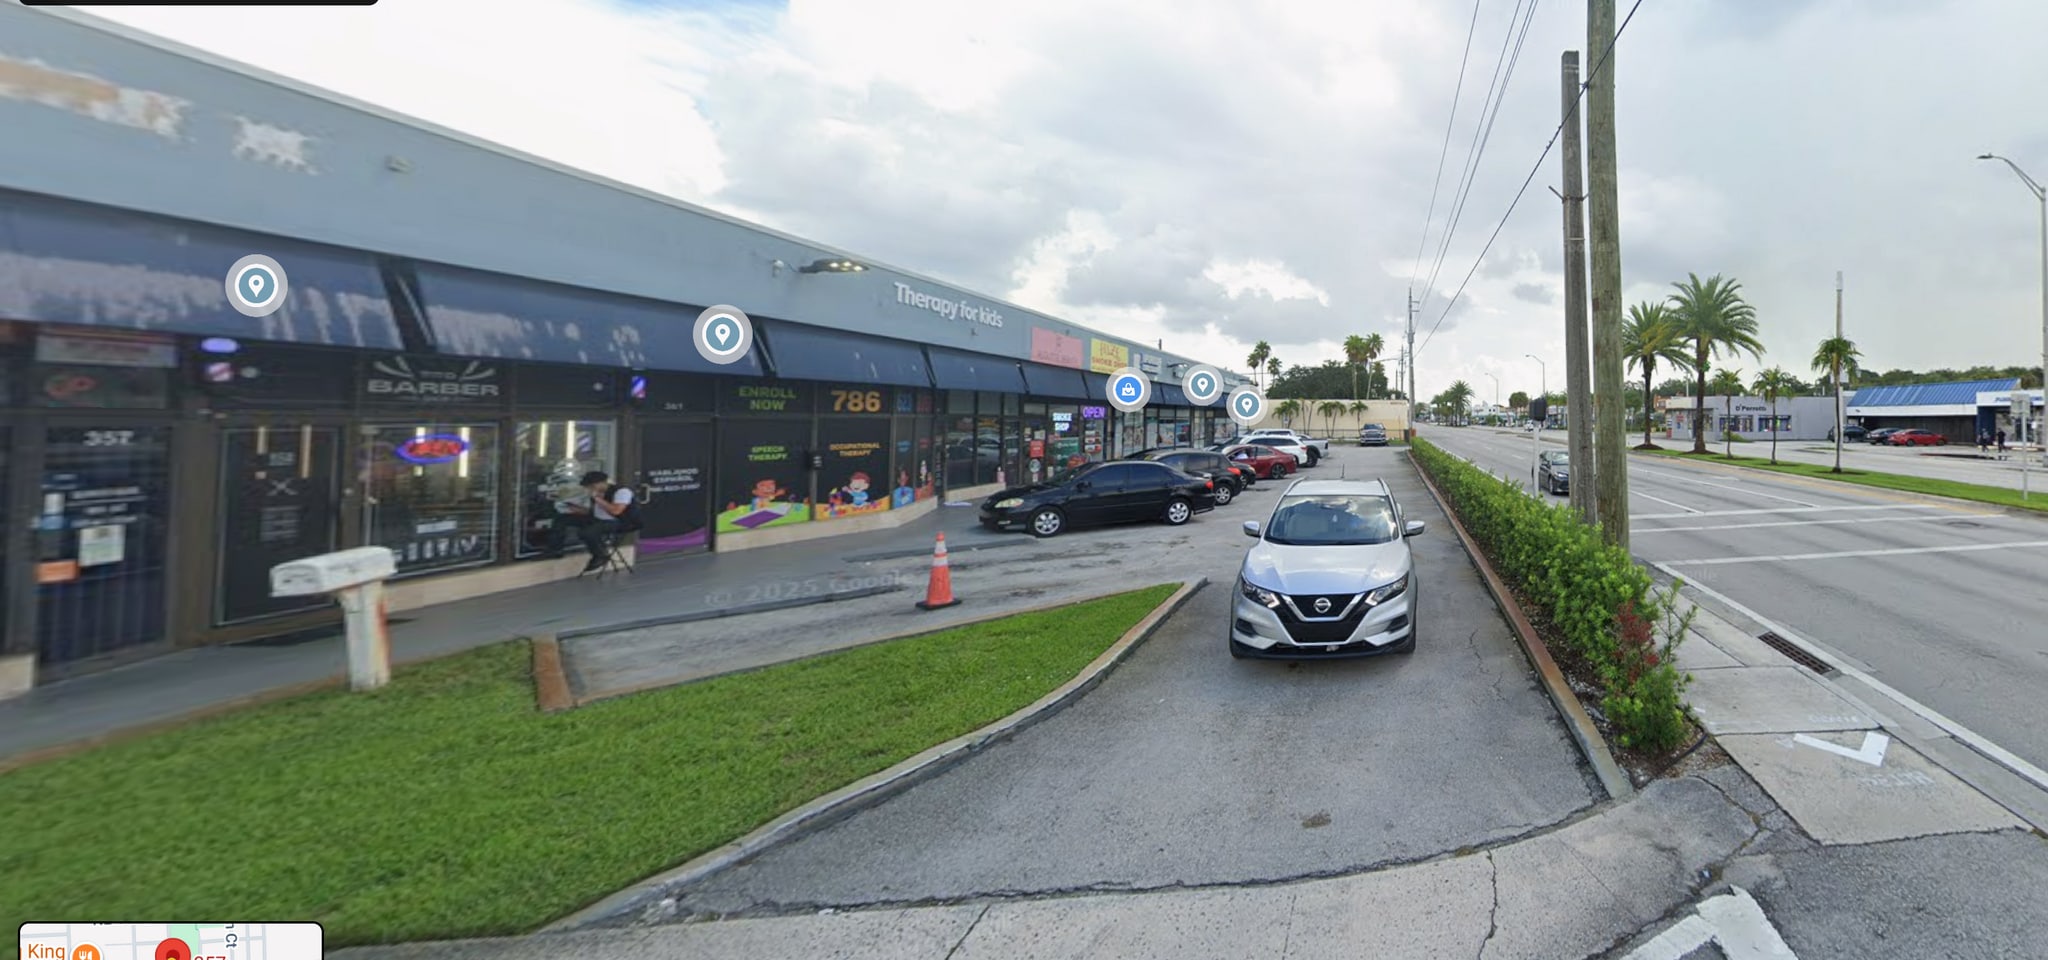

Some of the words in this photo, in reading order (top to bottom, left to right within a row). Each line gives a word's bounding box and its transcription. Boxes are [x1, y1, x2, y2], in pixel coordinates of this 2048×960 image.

[894, 281, 958, 320] Therapy
[959, 301, 978, 321] for
[980, 306, 1003, 328] kids
[367, 379, 499, 396] BARBER
[739, 386, 797, 399] ENROLL
[750, 399, 786, 411] NOW
[831, 390, 881, 412] 786
[1053, 412, 1072, 421] SMOKE
[1083, 406, 1104, 418] OPEN
[1055, 422, 1070, 431] SHOP
[83, 430, 134, 446] 357
[829, 442, 880, 451] OCCUPATIONAL
[747, 453, 789, 461] THERAPY
[839, 449, 872, 457] THERAPY
